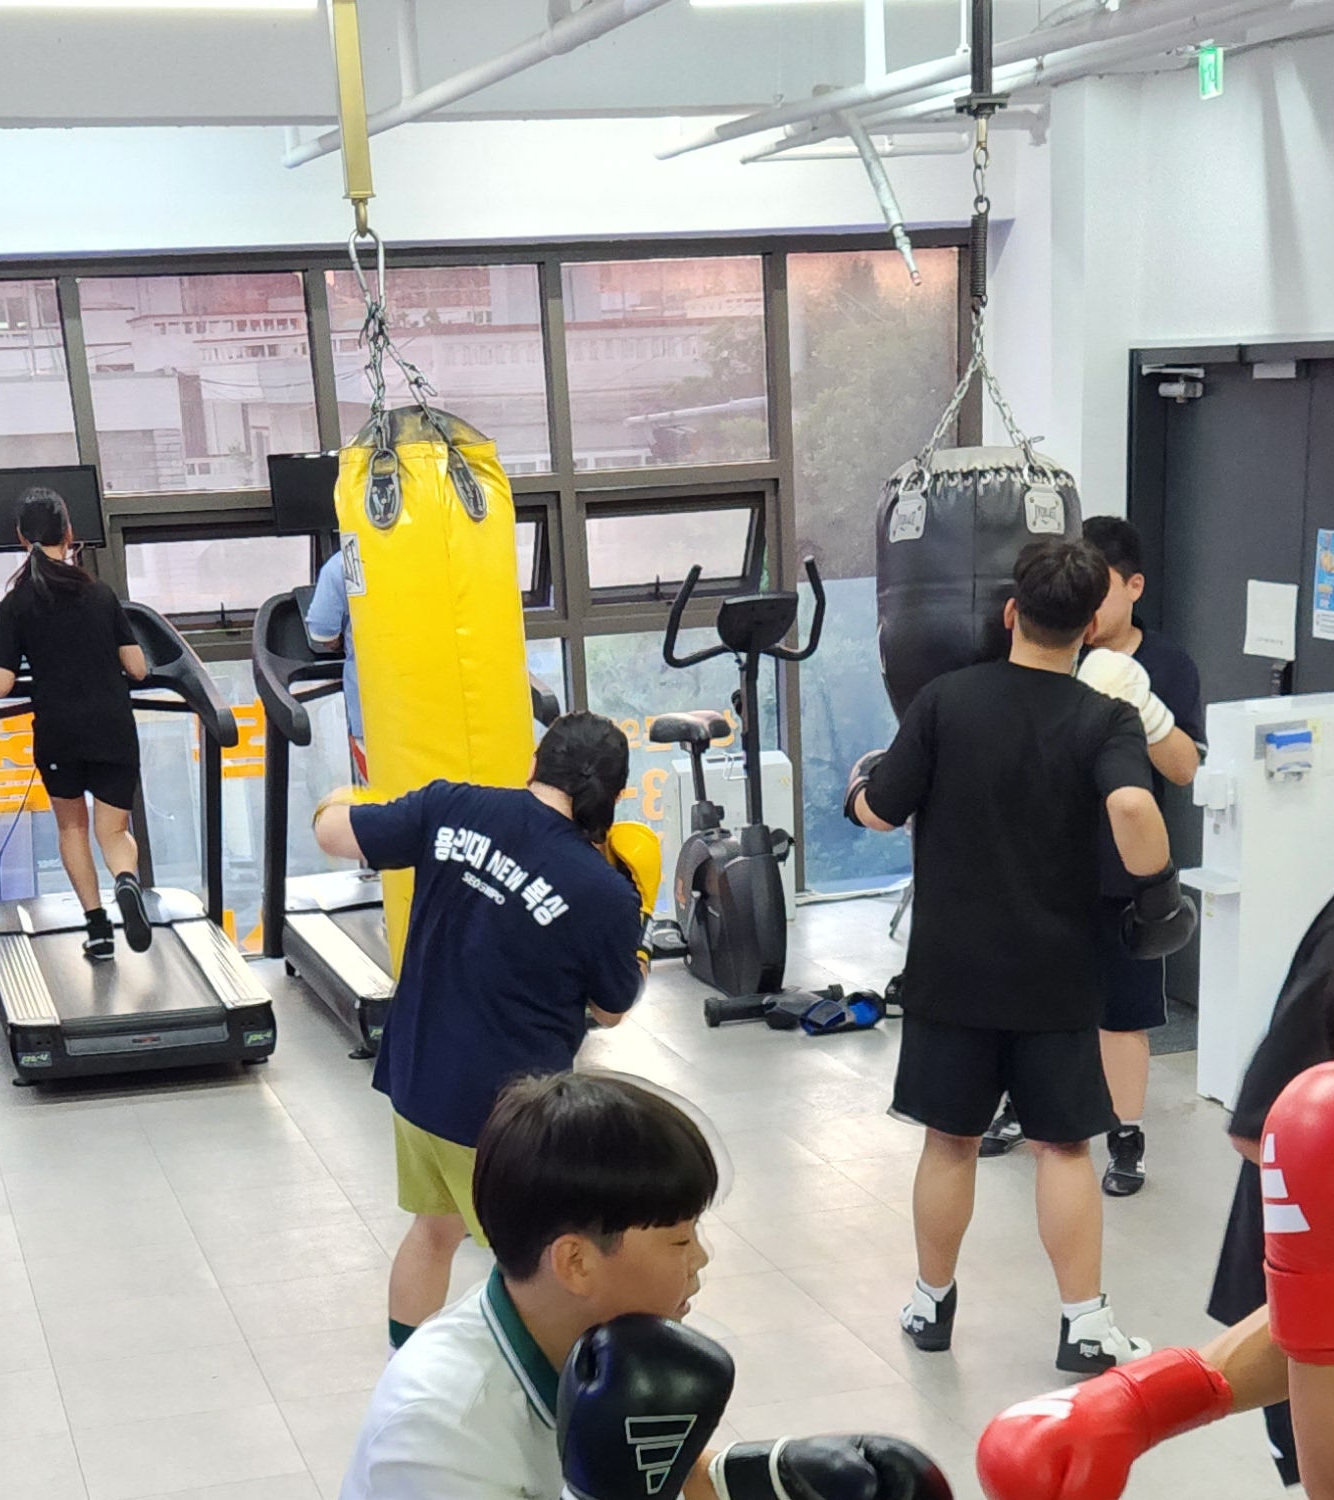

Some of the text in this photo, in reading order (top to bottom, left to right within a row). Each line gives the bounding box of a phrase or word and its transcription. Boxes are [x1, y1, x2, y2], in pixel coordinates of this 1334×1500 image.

[434, 826, 570, 926] 용인대 NEW 복싱
